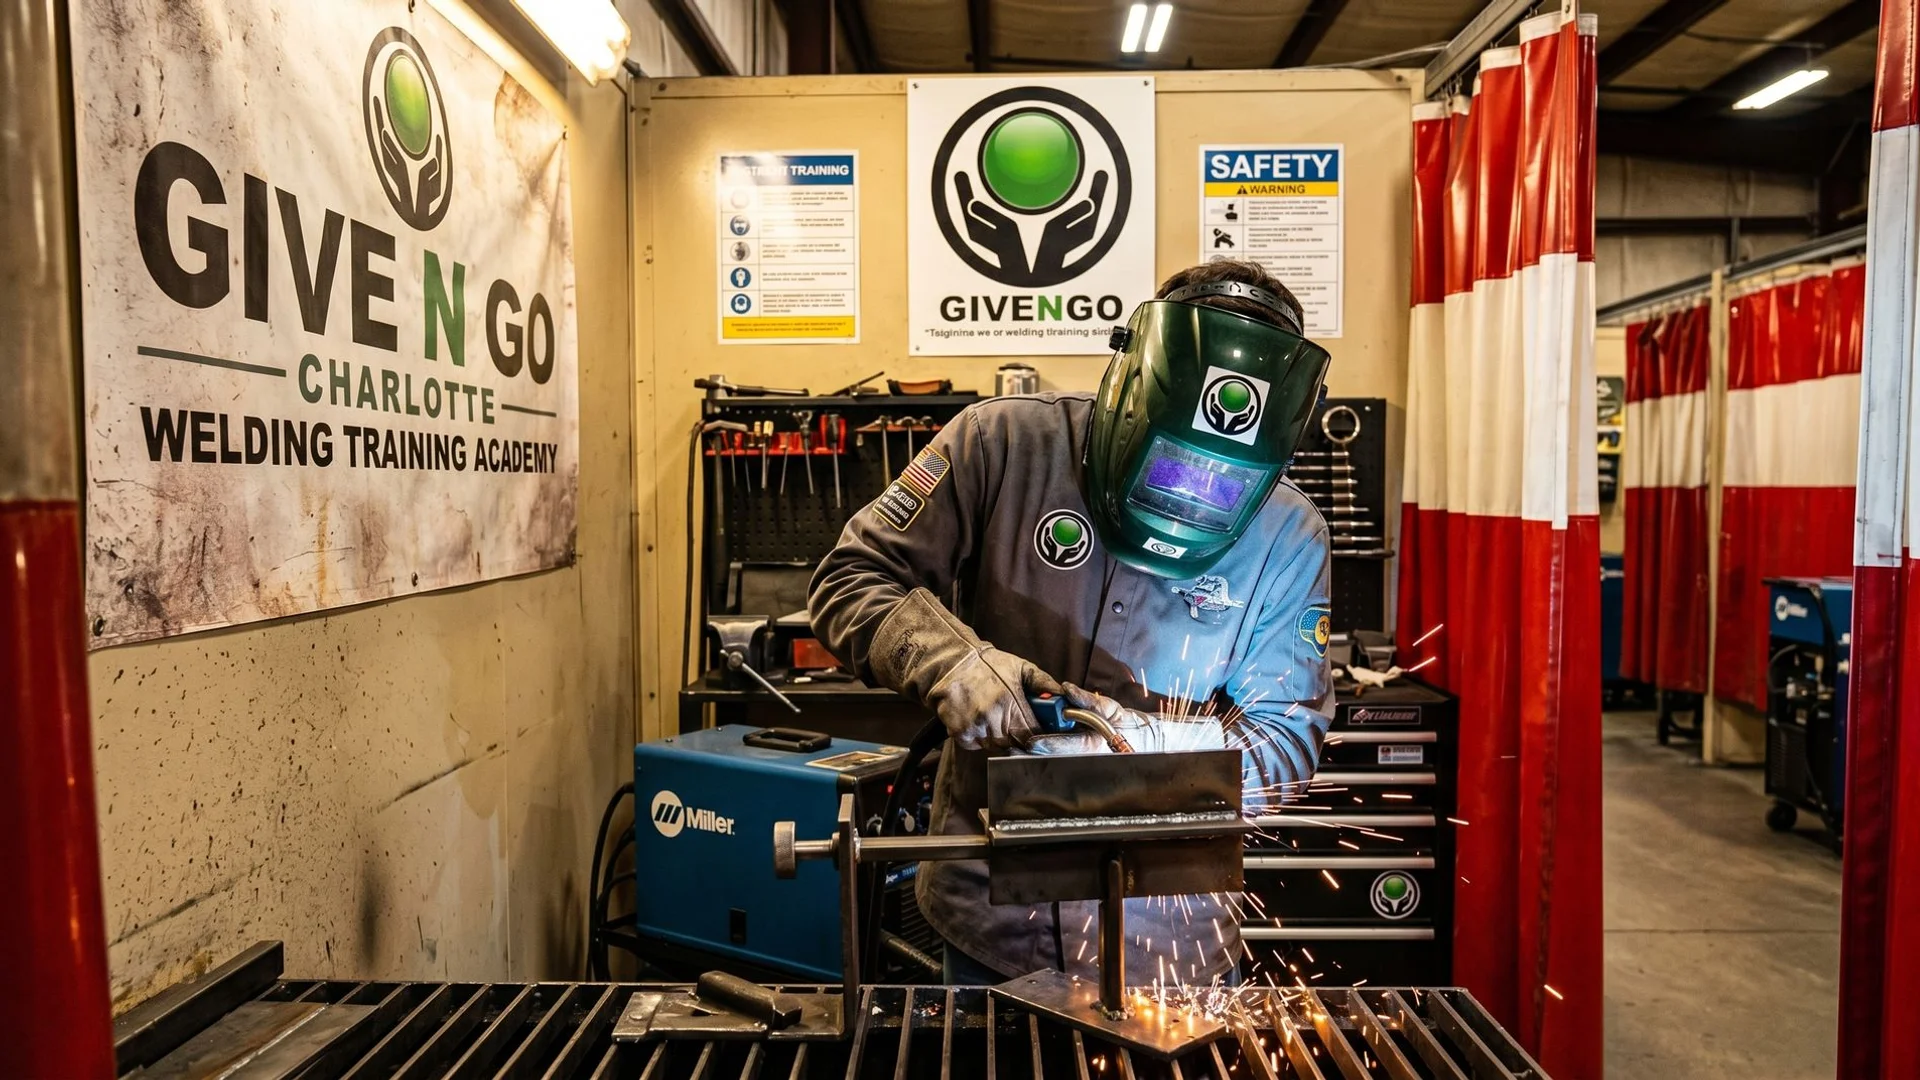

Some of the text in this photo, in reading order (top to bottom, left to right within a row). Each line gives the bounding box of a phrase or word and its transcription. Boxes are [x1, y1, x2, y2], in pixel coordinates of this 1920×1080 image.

[790, 165, 850, 176] TRAINING
[1210, 153, 1333, 179] SAFETY
[1250, 184, 1306, 194] WARNING
[134, 140, 555, 385] GIVE N GO
[939, 295, 1123, 322] GIVENGO
[977, 329, 991, 337] we
[993, 329, 1003, 337] or
[1005, 328, 1044, 339] welding
[298, 353, 495, 425] CHARLOTTE
[139, 406, 558, 474] WELDING TRAINING ACADEMY
